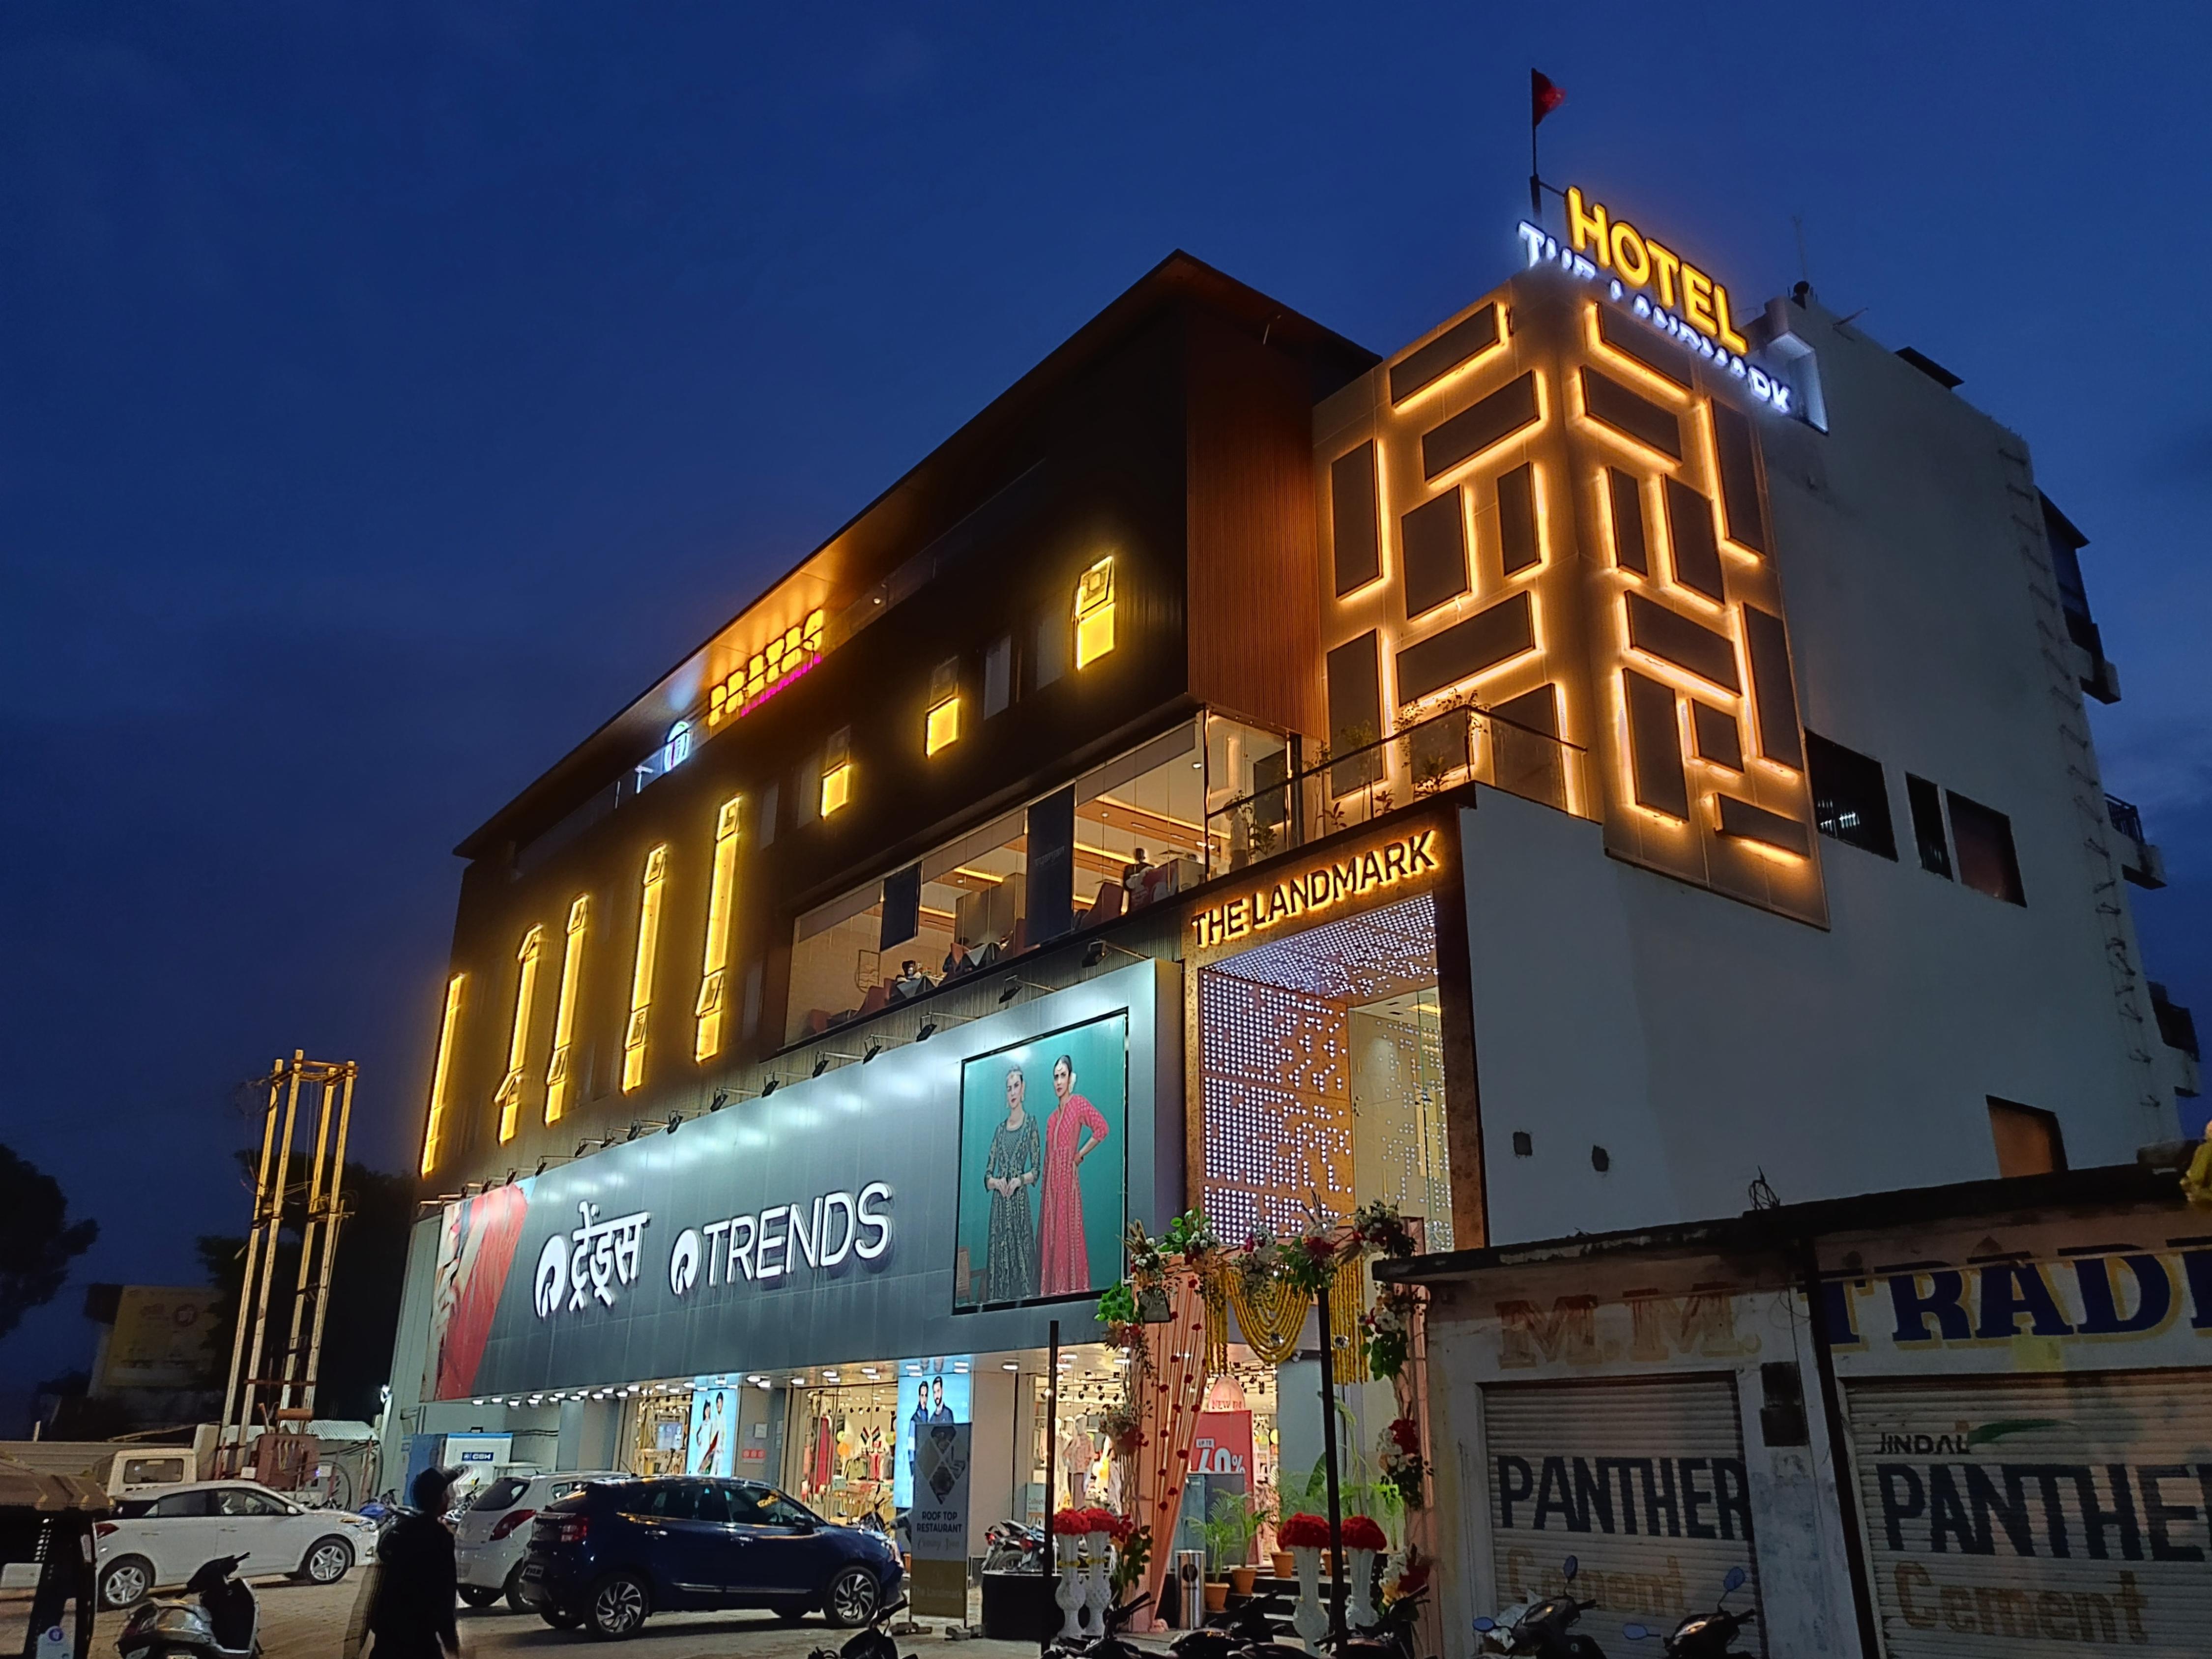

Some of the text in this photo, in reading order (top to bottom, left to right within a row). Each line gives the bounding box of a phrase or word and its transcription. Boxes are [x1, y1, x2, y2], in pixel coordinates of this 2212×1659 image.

[1565, 186, 1749, 356] HOTEL
[1191, 830, 1439, 947] THE LANDMARK
[703, 1181, 894, 1287] TRENDS
[1212, 1400, 1230, 1409] NEW
[1874, 1432, 1971, 1455] JINDAL
[916, 1523, 962, 1533] RESTAURANT
[922, 1511, 958, 1521] ROOF TOP
[1497, 1455, 1756, 1541] PANTHER
[1876, 1462, 2212, 1562] PANTHE
[1893, 1561, 2149, 1645] Cement
